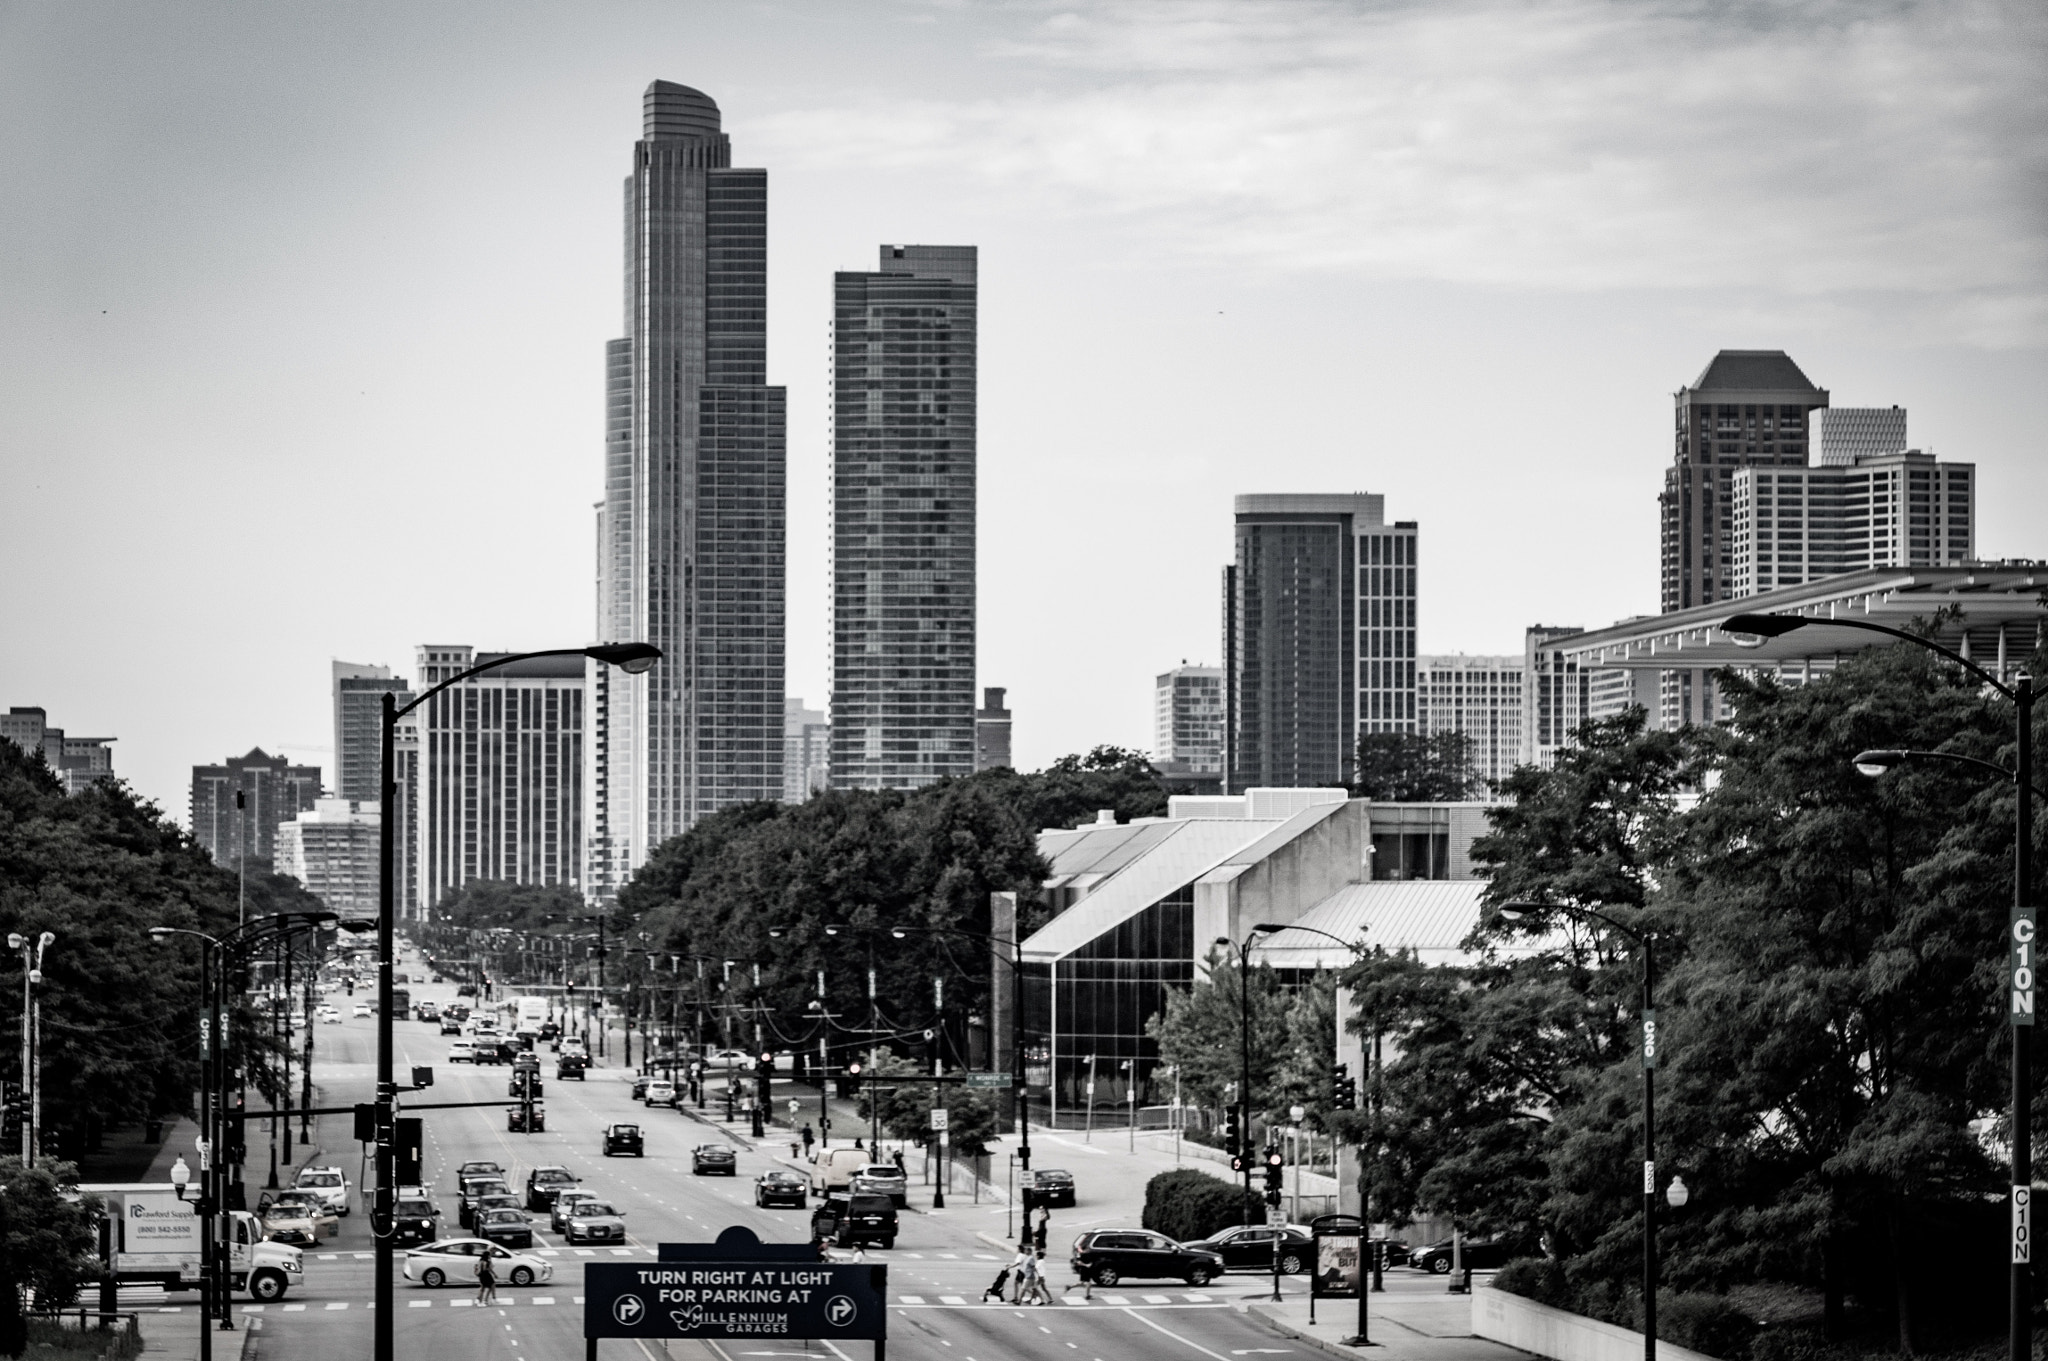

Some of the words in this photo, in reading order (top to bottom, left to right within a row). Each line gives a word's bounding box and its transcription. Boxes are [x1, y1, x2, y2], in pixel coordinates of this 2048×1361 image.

[2012, 918, 2034, 1014] C10N
[200, 1018, 210, 1050] C31
[220, 1012, 229, 1041] C41
[1643, 1020, 1655, 1058] C20
[2015, 1189, 2028, 1260] C10N
[637, 1271, 687, 1285] TURN
[692, 1271, 746, 1285] RIGHT
[751, 1272, 775, 1285] AT
[780, 1272, 833, 1286] LIGHT
[659, 1289, 697, 1303] FOR
[702, 1289, 782, 1303] PARKING
[787, 1290, 812, 1303] AT
[692, 1313, 788, 1323] MILLENNIUM
[726, 1324, 788, 1333] GARAGES
